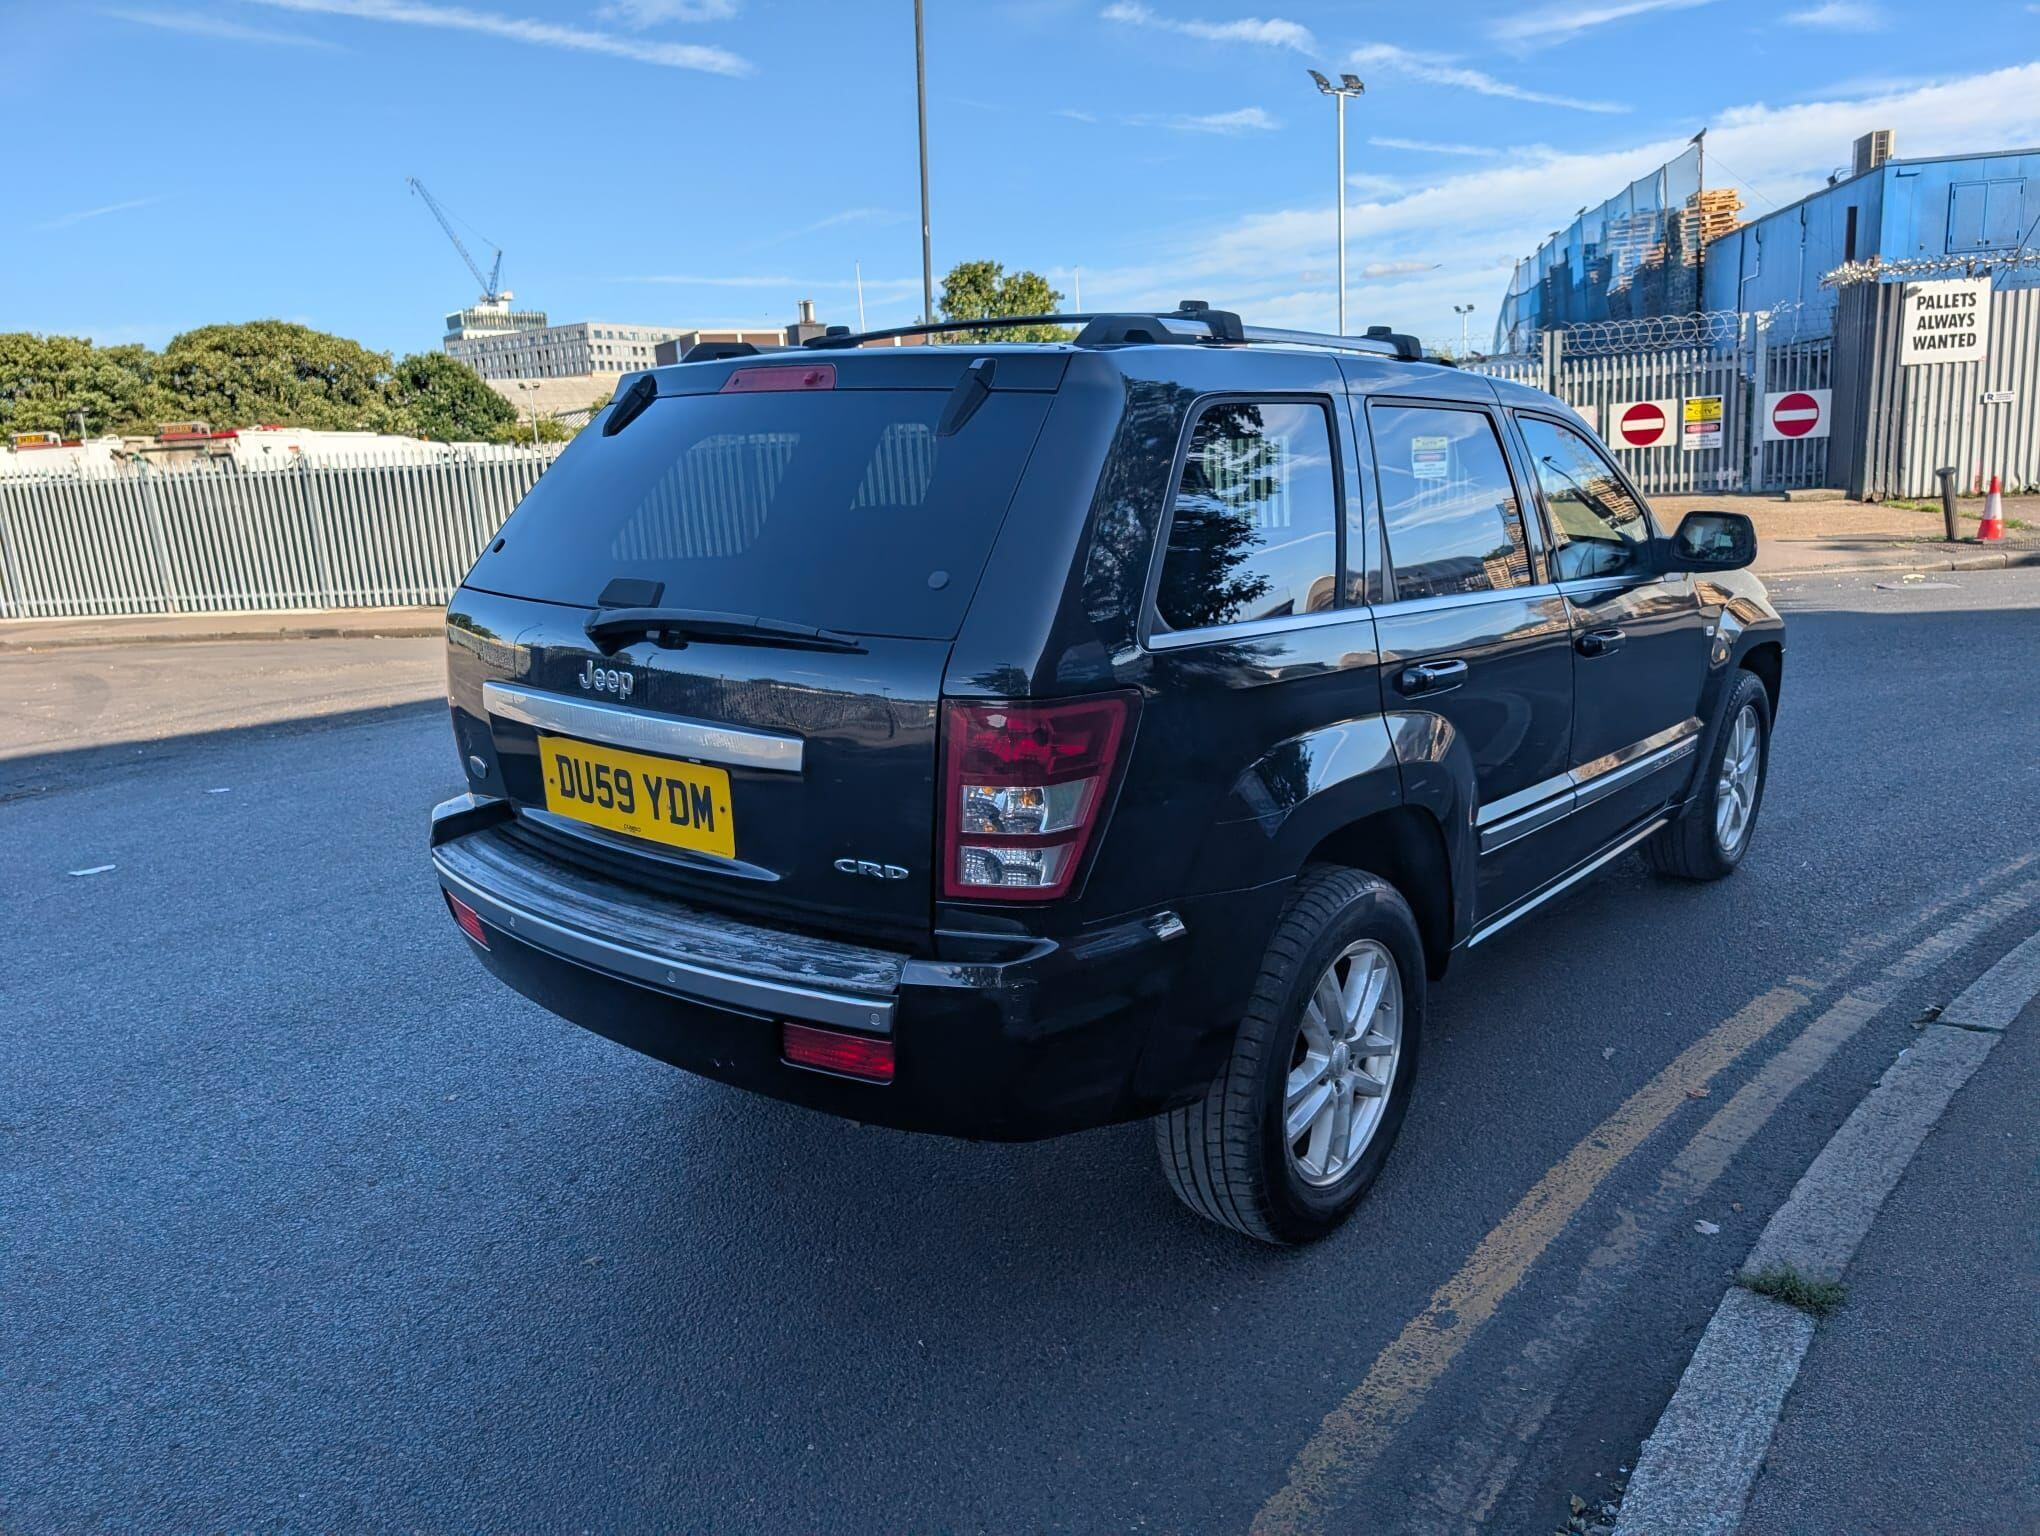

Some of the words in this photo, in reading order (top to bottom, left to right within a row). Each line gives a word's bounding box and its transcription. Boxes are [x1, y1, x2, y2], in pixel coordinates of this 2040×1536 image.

[1916, 292, 1977, 311] PALLETS
[1916, 312, 1976, 331] ALWAYS
[1912, 332, 1977, 351] WANTED
[578, 659, 634, 700] Jeep
[555, 753, 636, 815] DU59
[642, 773, 715, 833] YDM
[833, 858, 910, 880] CRD
